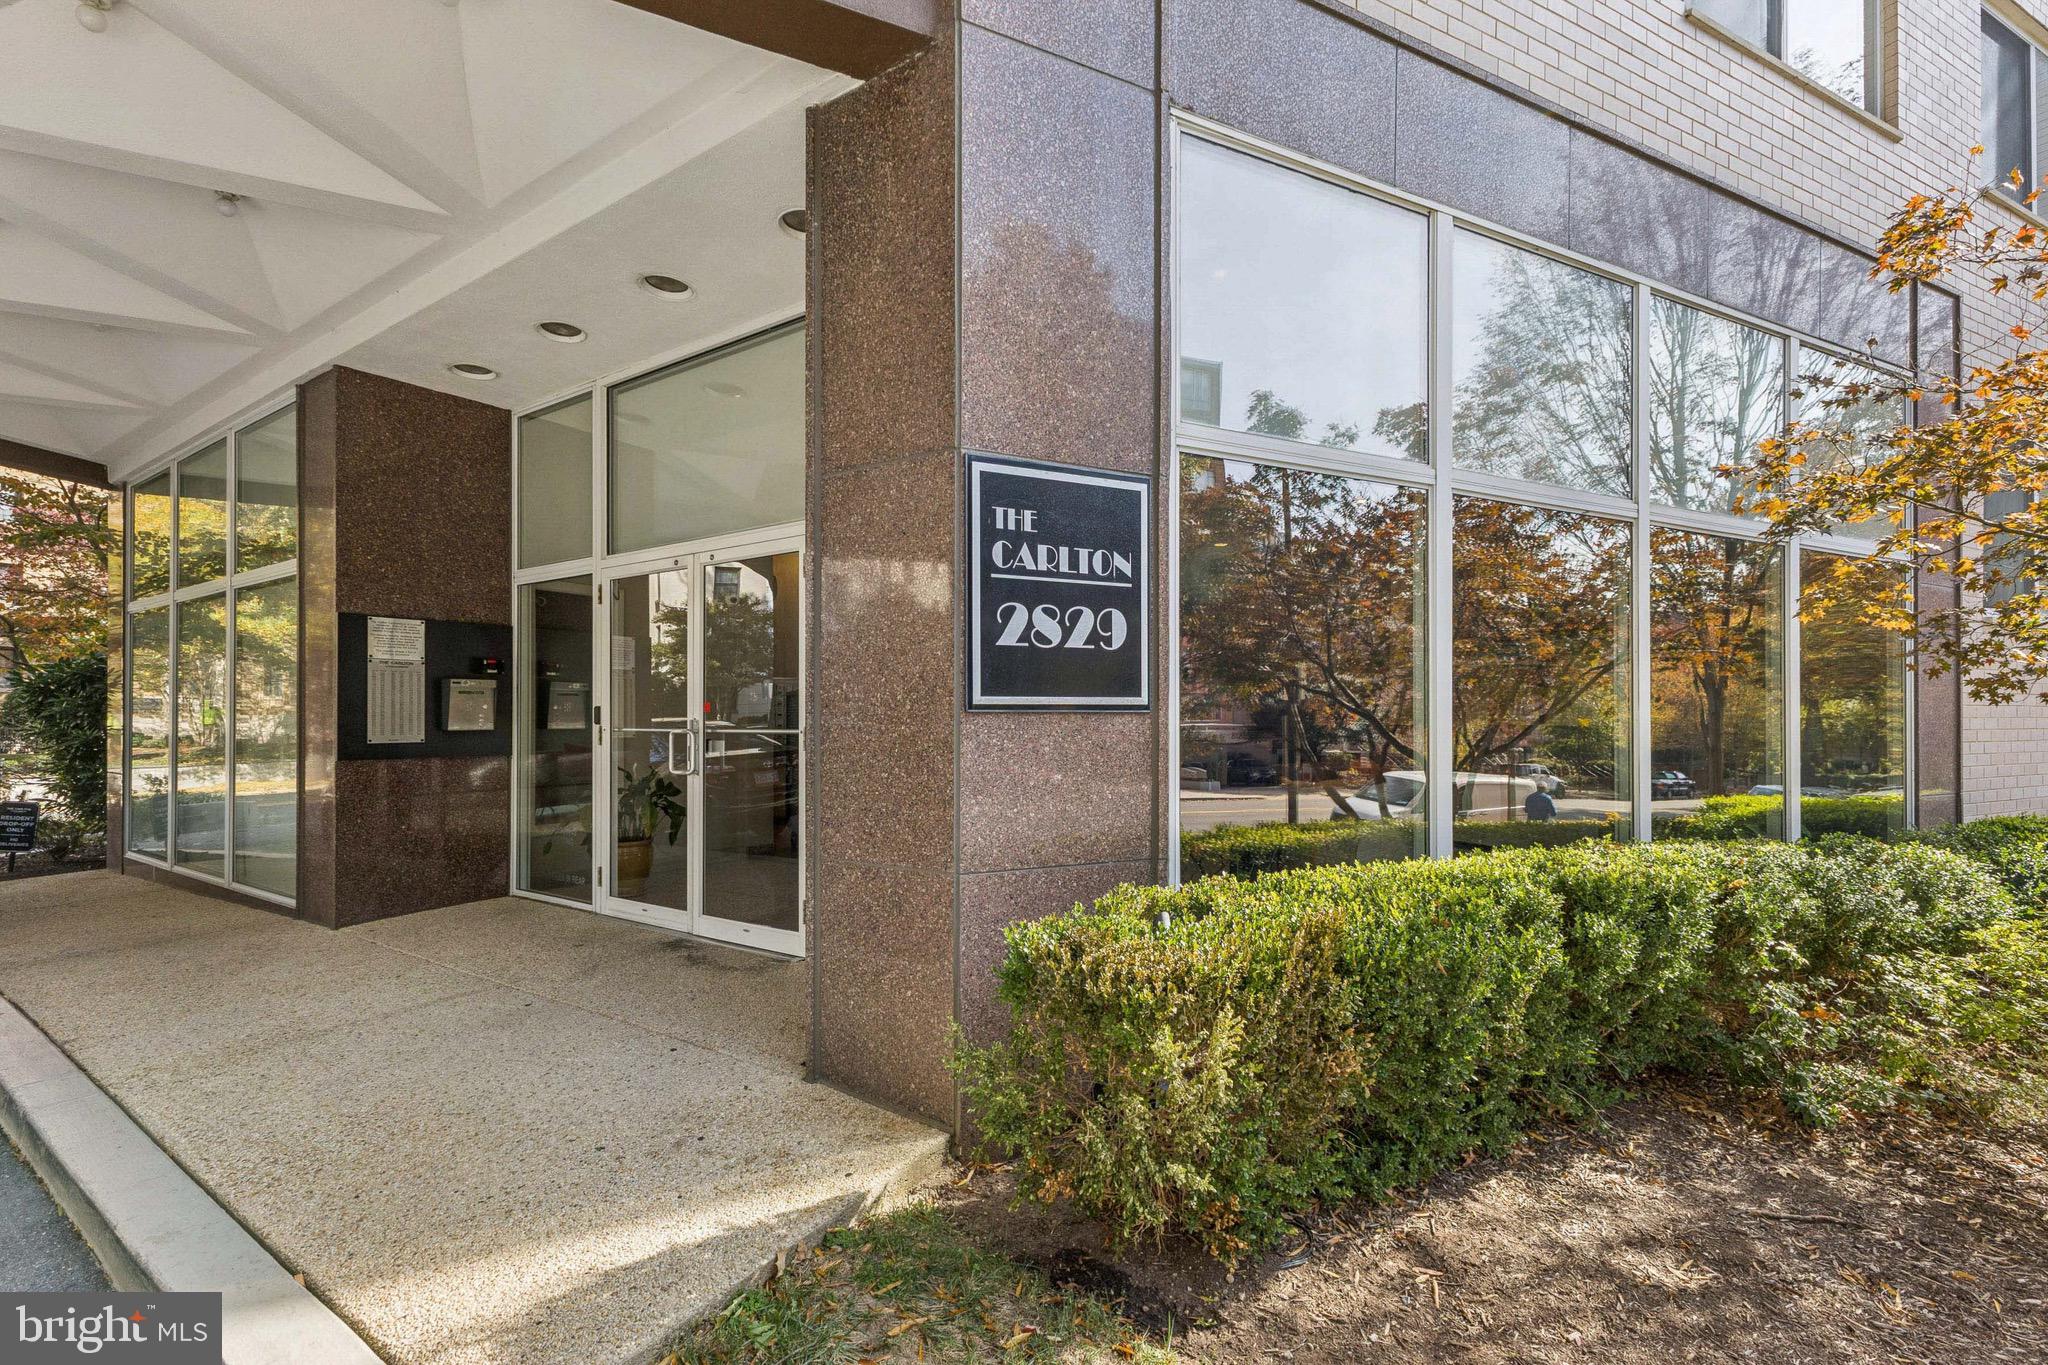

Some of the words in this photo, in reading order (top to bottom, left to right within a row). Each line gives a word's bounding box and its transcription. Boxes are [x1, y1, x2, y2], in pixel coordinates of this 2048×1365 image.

[991, 506, 1038, 533] THE
[991, 540, 1132, 579] CARLTON
[995, 602, 1128, 651] 2829
